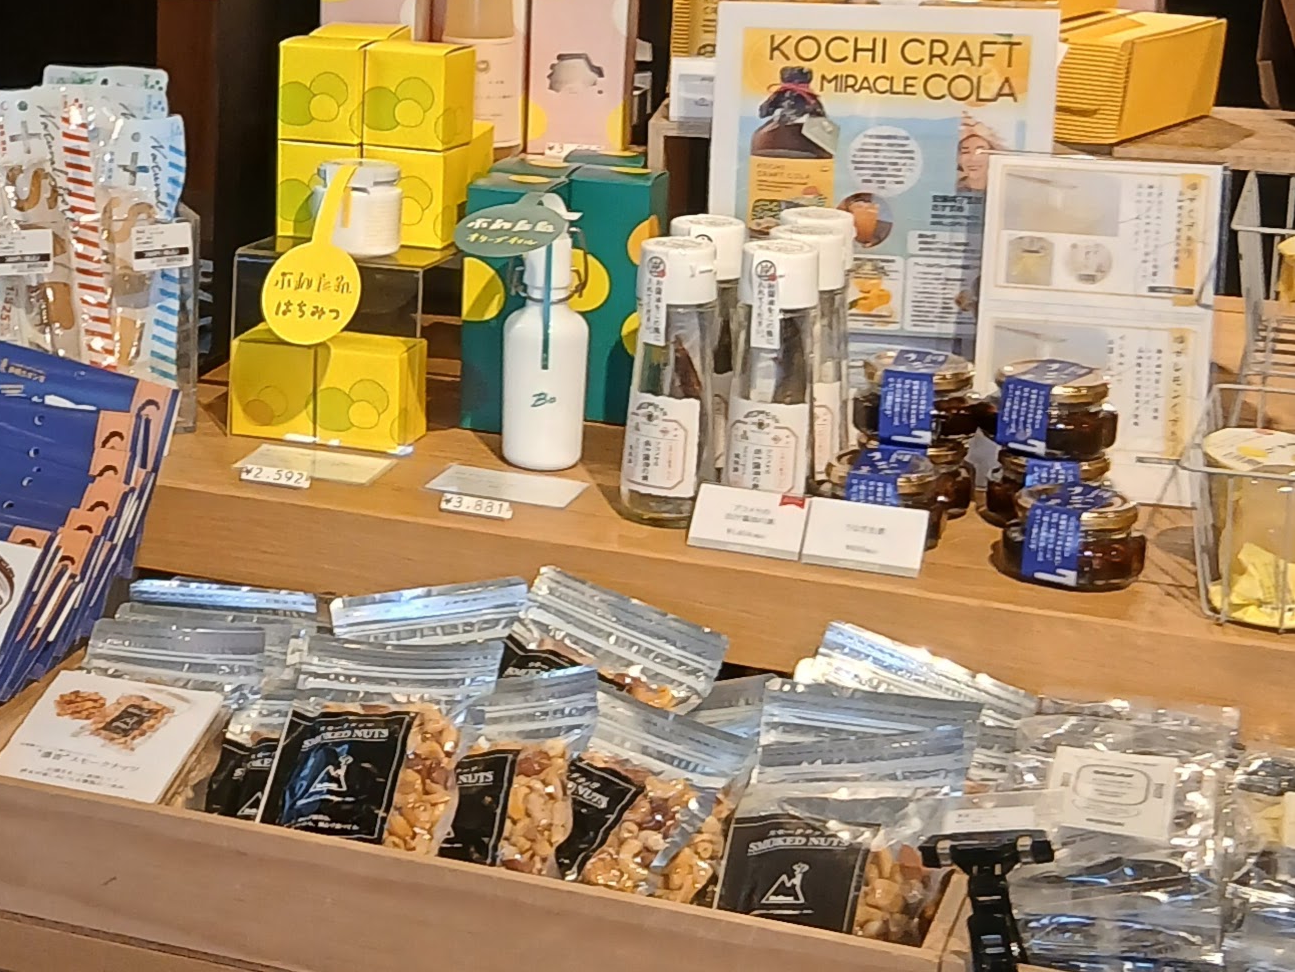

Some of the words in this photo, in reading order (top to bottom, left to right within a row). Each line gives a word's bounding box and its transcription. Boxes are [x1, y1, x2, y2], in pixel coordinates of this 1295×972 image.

[768, 34, 887, 64] KOCHI
[900, 38, 1023, 68] CRAFT
[819, 73, 918, 96] MIRACLE
[923, 74, 1018, 103] COLA
[274, 299, 341, 321] はちみつ
[351, 728, 389, 740] NUTS
[748, 834, 805, 851] SMOKED
